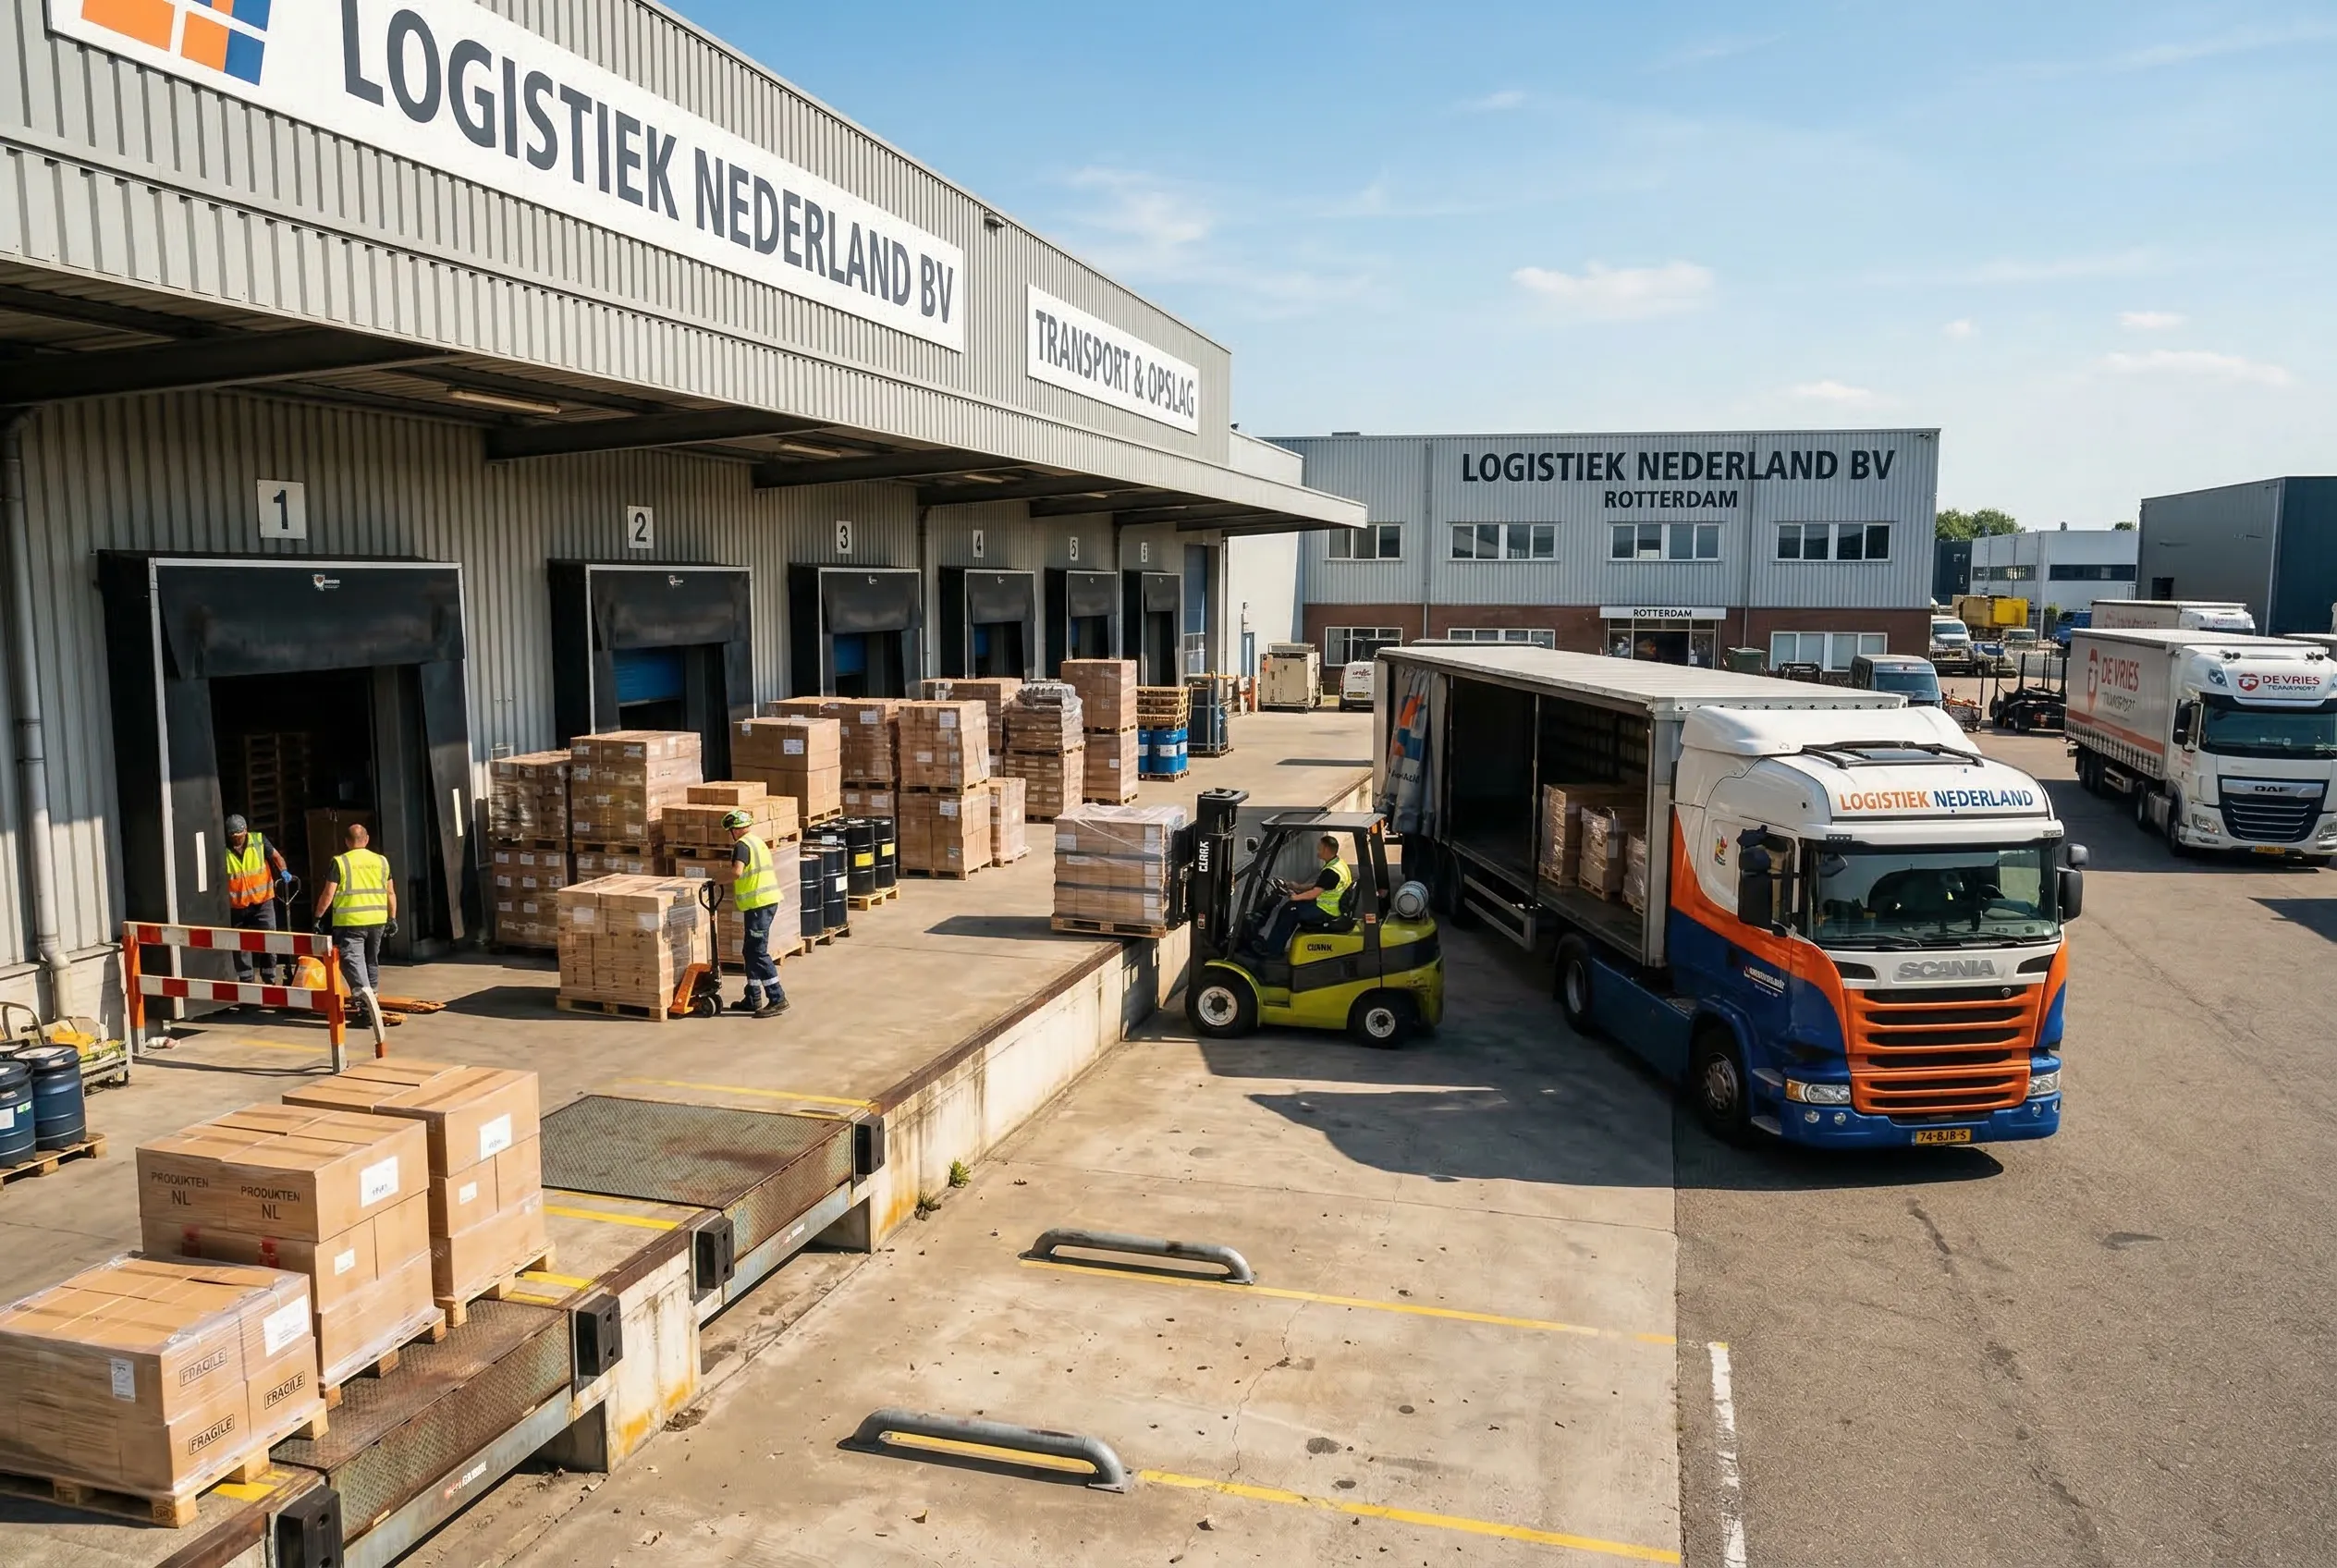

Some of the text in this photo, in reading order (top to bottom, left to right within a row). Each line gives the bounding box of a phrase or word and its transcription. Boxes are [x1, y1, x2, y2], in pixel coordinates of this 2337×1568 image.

[341, 0, 953, 324] LOGISTIEK NEDERLAND BV
[1035, 309, 1194, 419] TRANSPORT & OPSLAG
[1462, 449, 1895, 483] LOGISTIEK NEDERLAND BV
[273, 489, 288, 530] 1
[1604, 490, 1738, 508] ROTTERDAM
[634, 512, 647, 543] 2
[839, 525, 849, 549] 3
[1633, 609, 1692, 618] ROTTERDAM
[2101, 655, 2140, 692] DE VRIES
[2262, 675, 2320, 685] DE VRIES
[1839, 790, 2034, 811] LOGISTIEK NEDERLAND
[1898, 959, 1996, 979] SCANIA
[151, 1171, 209, 1188] PRODUKTEN
[172, 1190, 191, 1207] NL
[240, 1185, 300, 1203] PRODUKTEN
[262, 1204, 281, 1220] NL
[182, 1352, 226, 1383] FRAGILE
[266, 1374, 304, 1405] FRAGILE
[190, 1417, 234, 1452] FRAGILE
